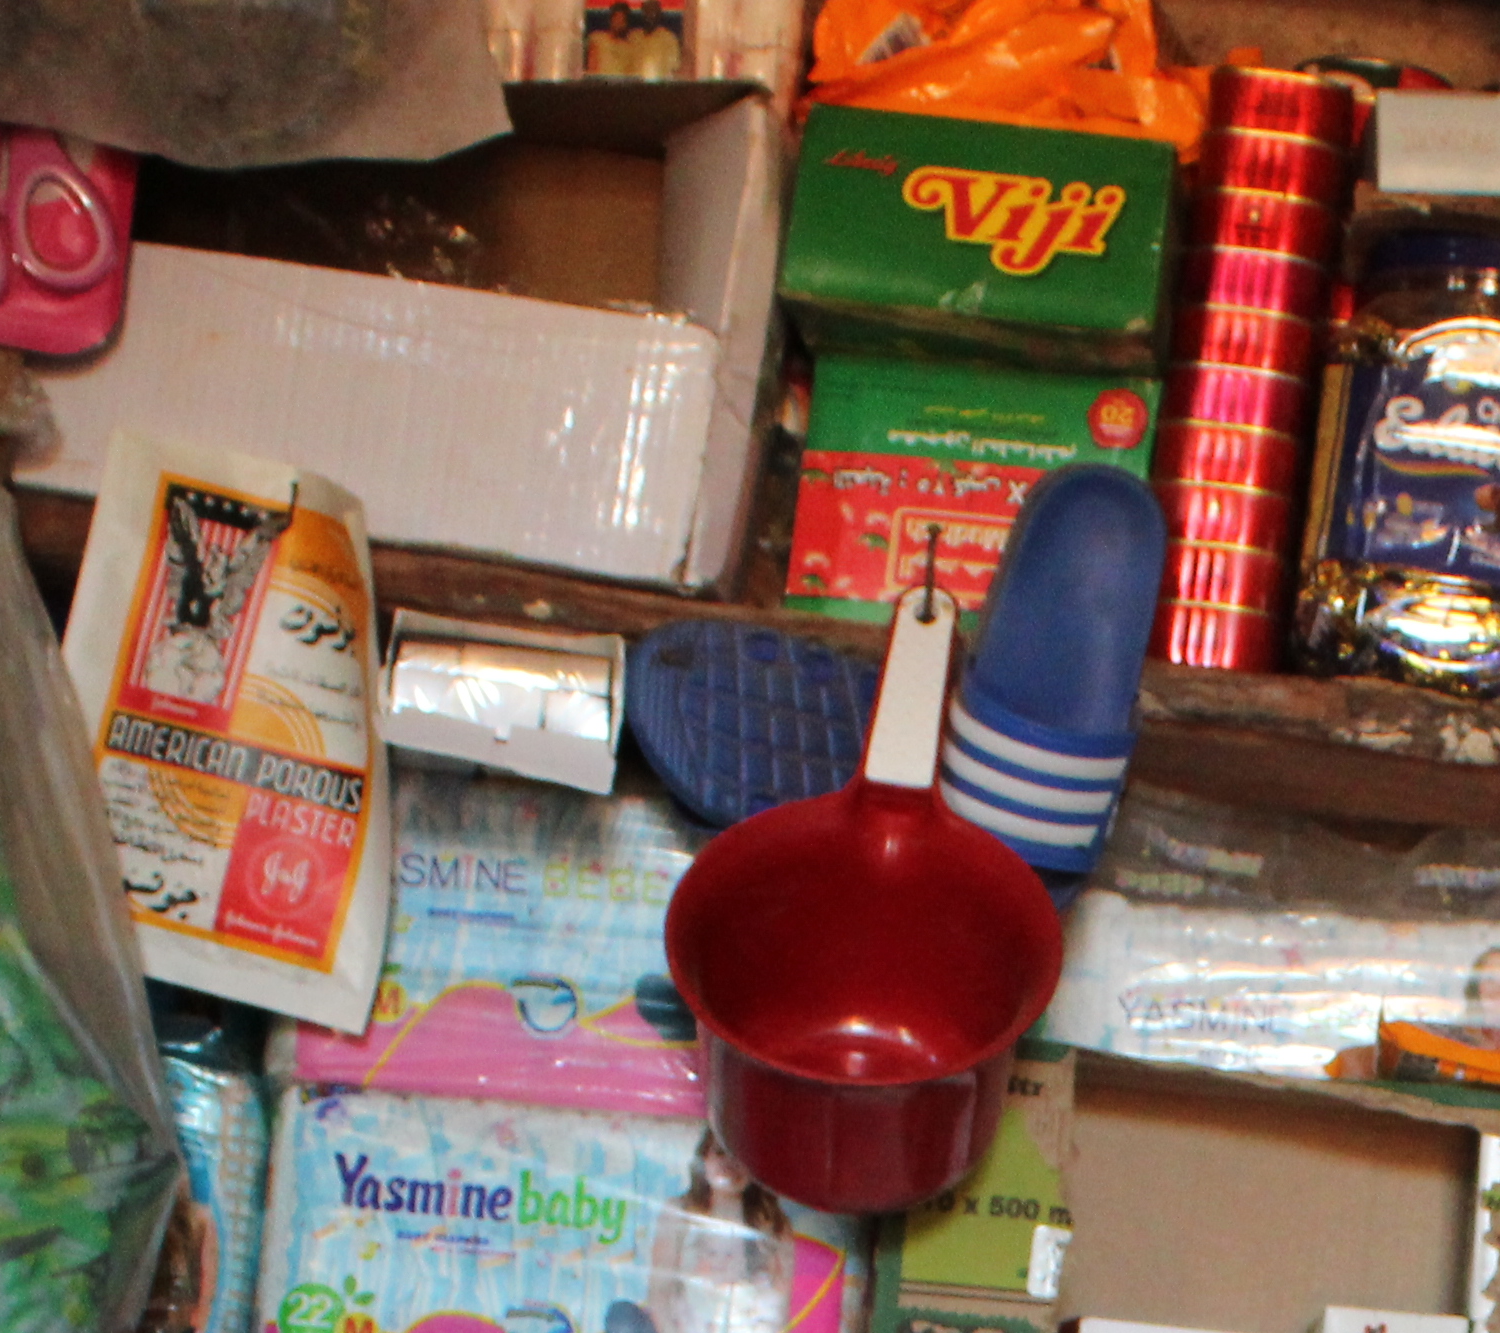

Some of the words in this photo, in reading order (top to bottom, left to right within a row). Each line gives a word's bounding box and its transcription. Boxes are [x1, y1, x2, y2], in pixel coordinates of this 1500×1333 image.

[902, 166, 1125, 275] Viji
[107, 713, 249, 781] AMERICAN
[257, 754, 363, 814] POROUS
[249, 792, 357, 847] PLASTER
[399, 853, 528, 895] SMINE
[335, 1152, 512, 1221] Yasmine
[519, 1169, 626, 1245] baby
[989, 1195, 1041, 1221] 500
[288, 1294, 333, 1328] 22
